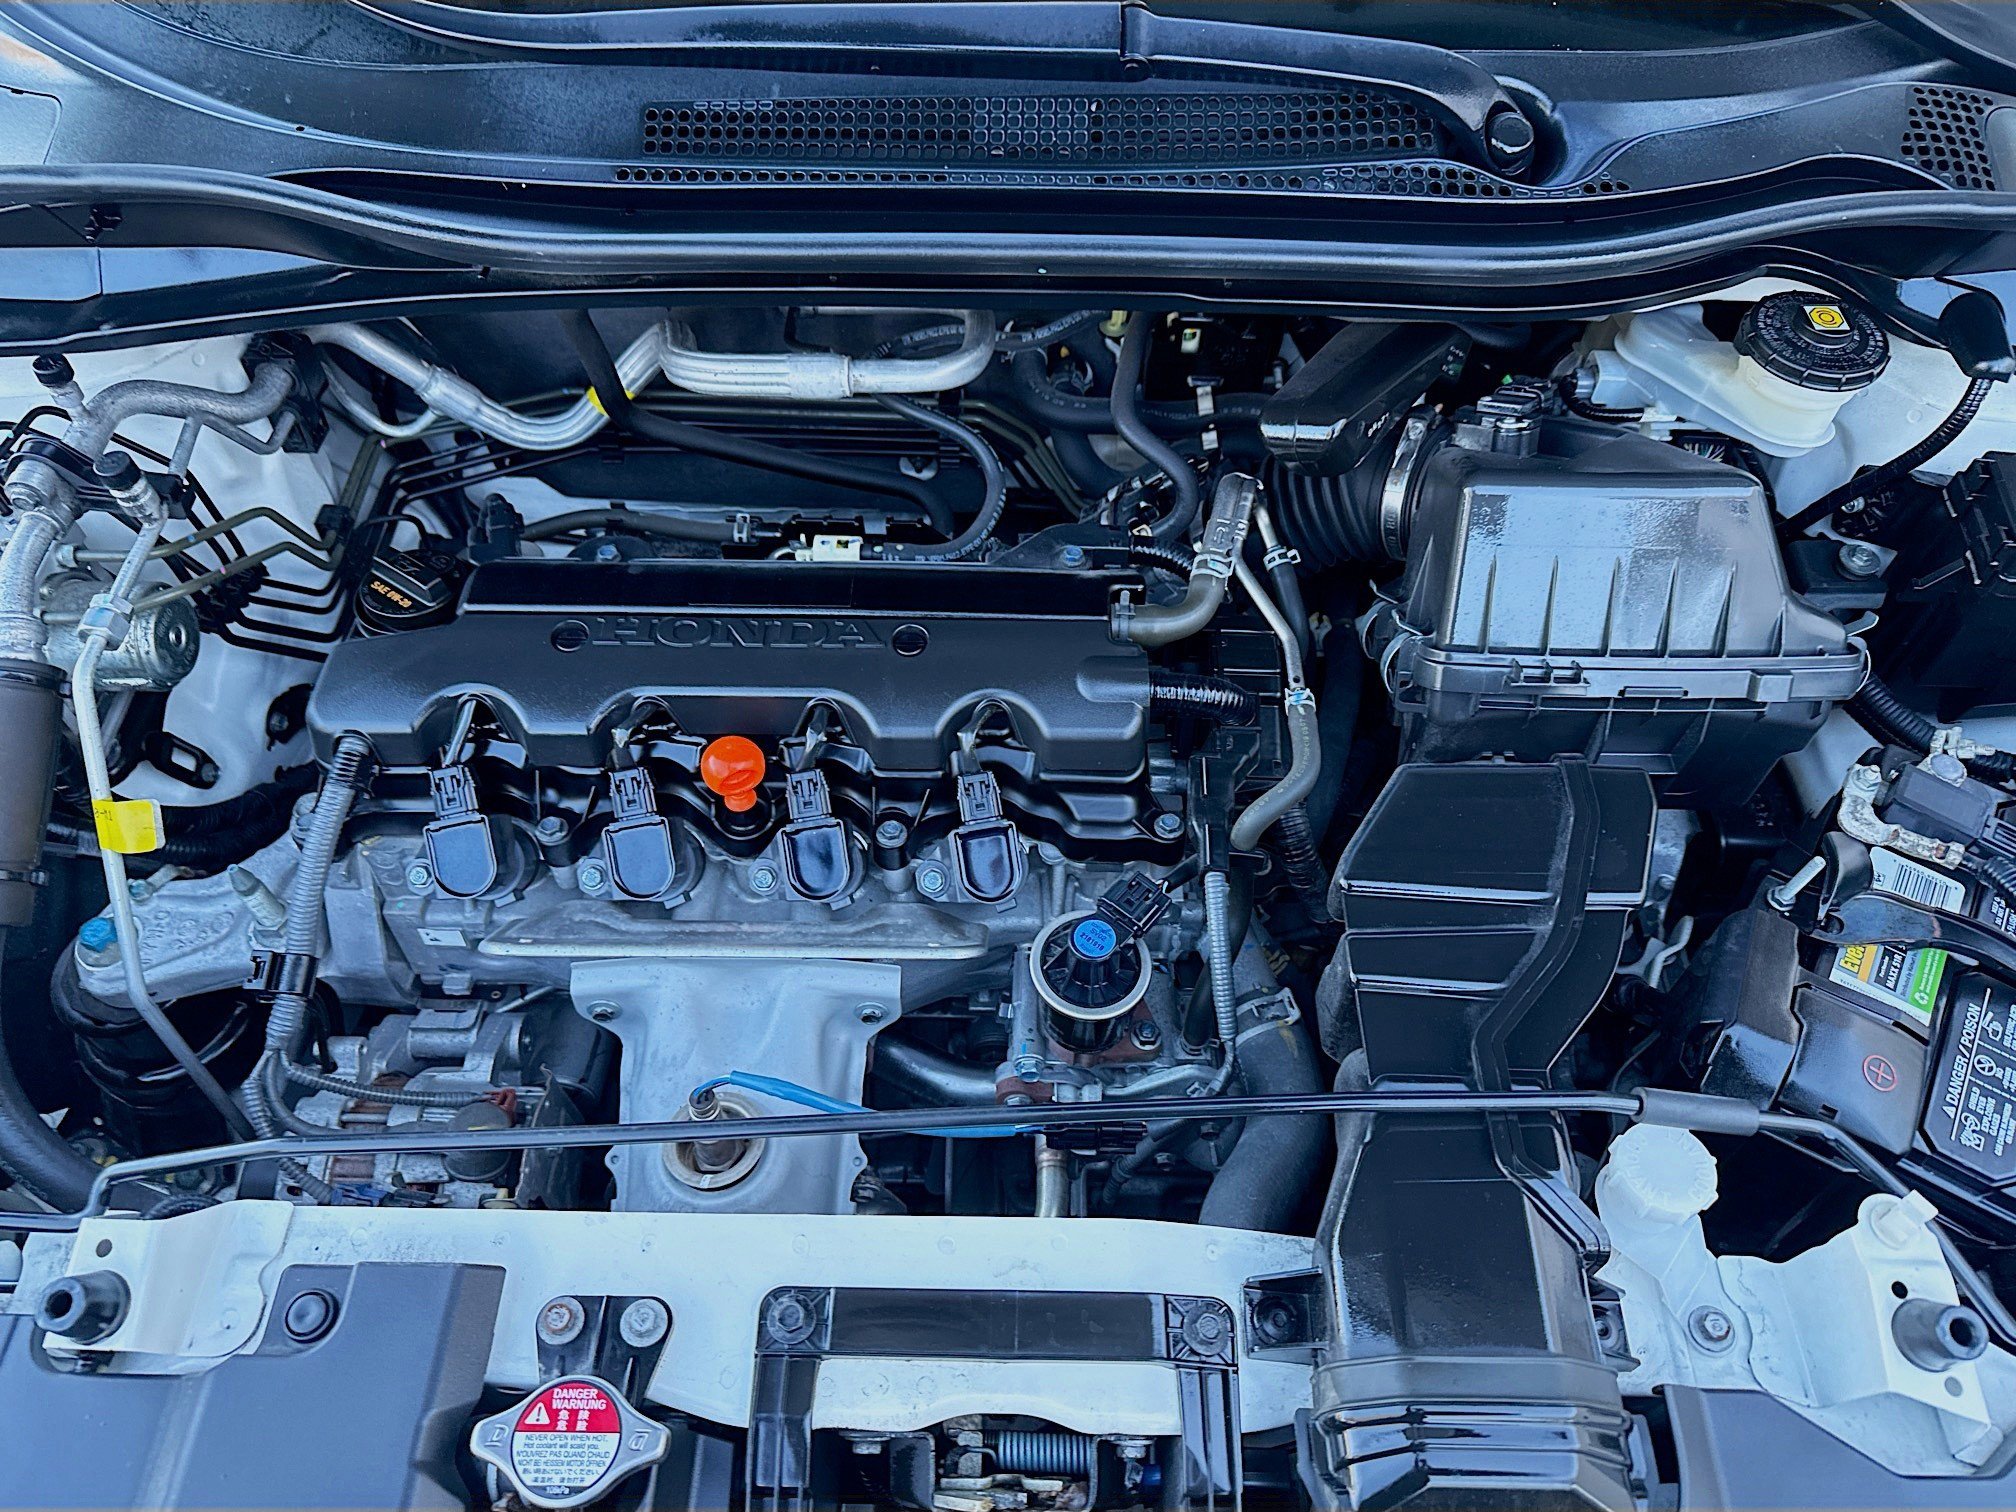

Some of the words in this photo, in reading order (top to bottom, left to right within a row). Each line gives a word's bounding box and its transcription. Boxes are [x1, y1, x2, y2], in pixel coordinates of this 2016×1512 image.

[370, 581, 391, 595] SAE
[592, 617, 885, 648] HONDA
[1886, 965, 1899, 989] MAXX
[553, 1388, 598, 1399] DANGER
[552, 1399, 607, 1410] WARNUNG
